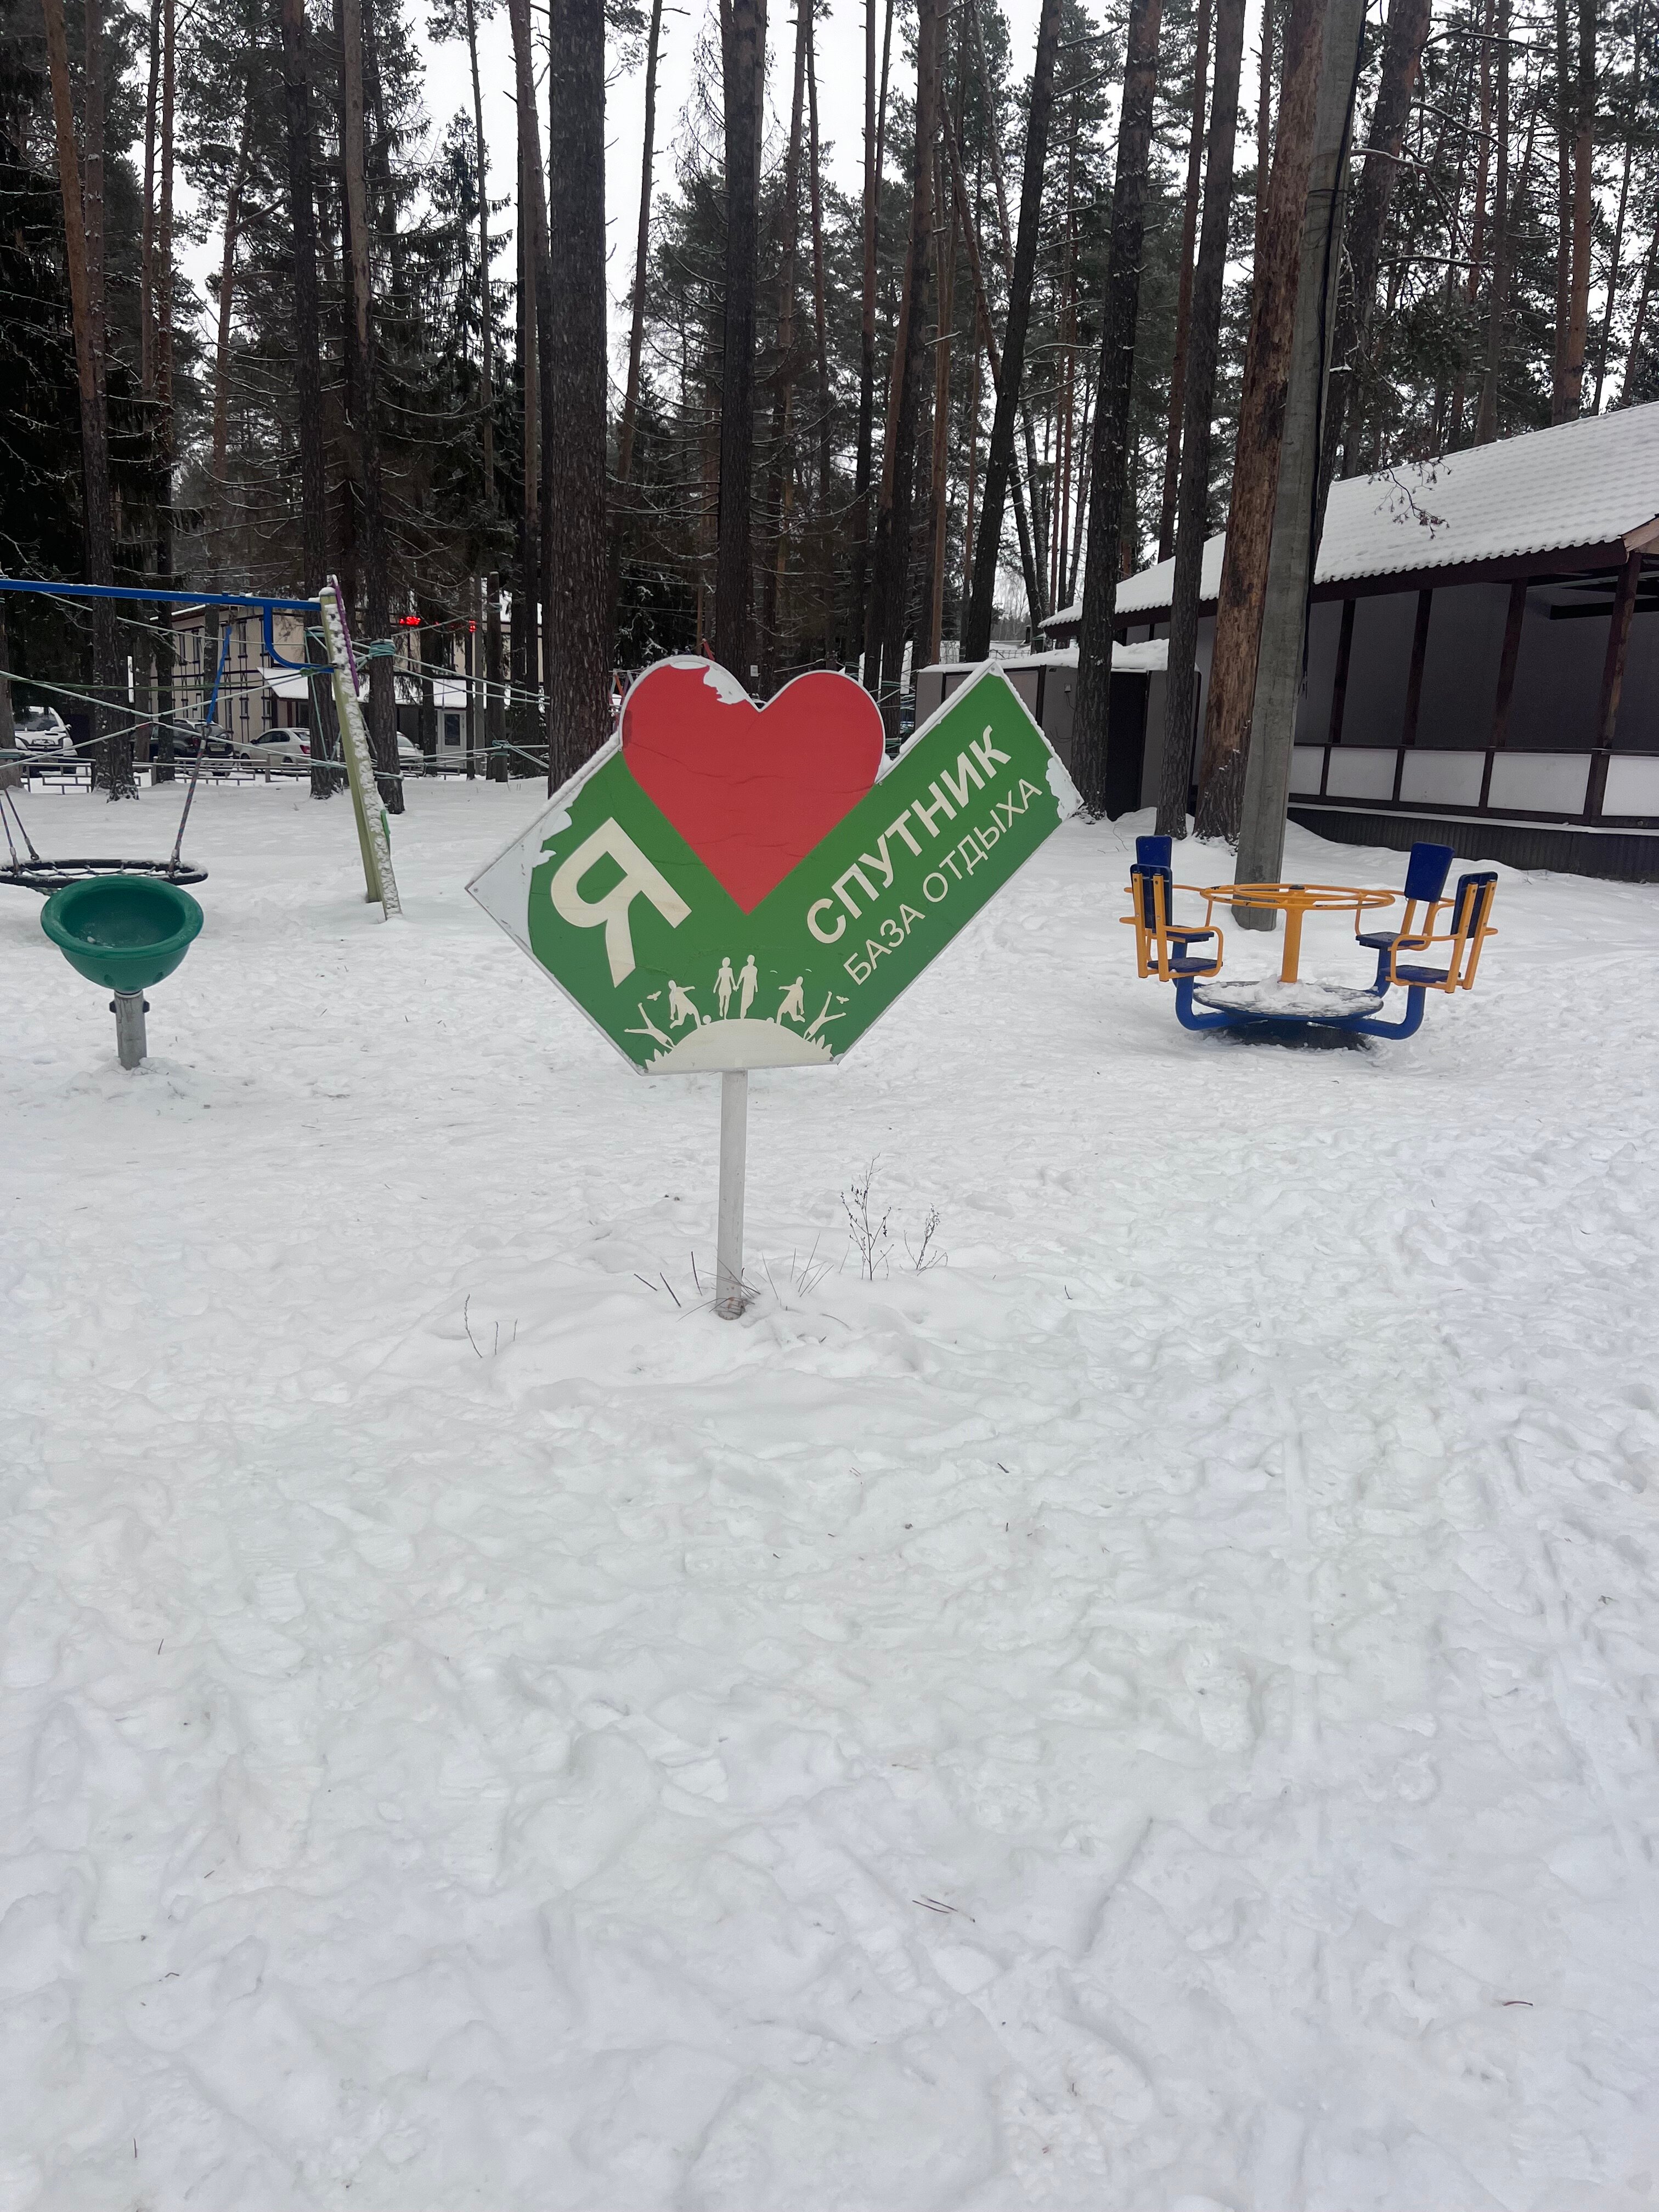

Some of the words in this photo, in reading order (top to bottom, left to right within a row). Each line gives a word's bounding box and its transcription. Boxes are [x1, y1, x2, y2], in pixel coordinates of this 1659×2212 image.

[550, 816, 692, 988] Я
[806, 725, 1012, 944] СПУТНИК
[843, 904, 926, 985] БАЗА
[923, 778, 1043, 902] ОТДЫХА
